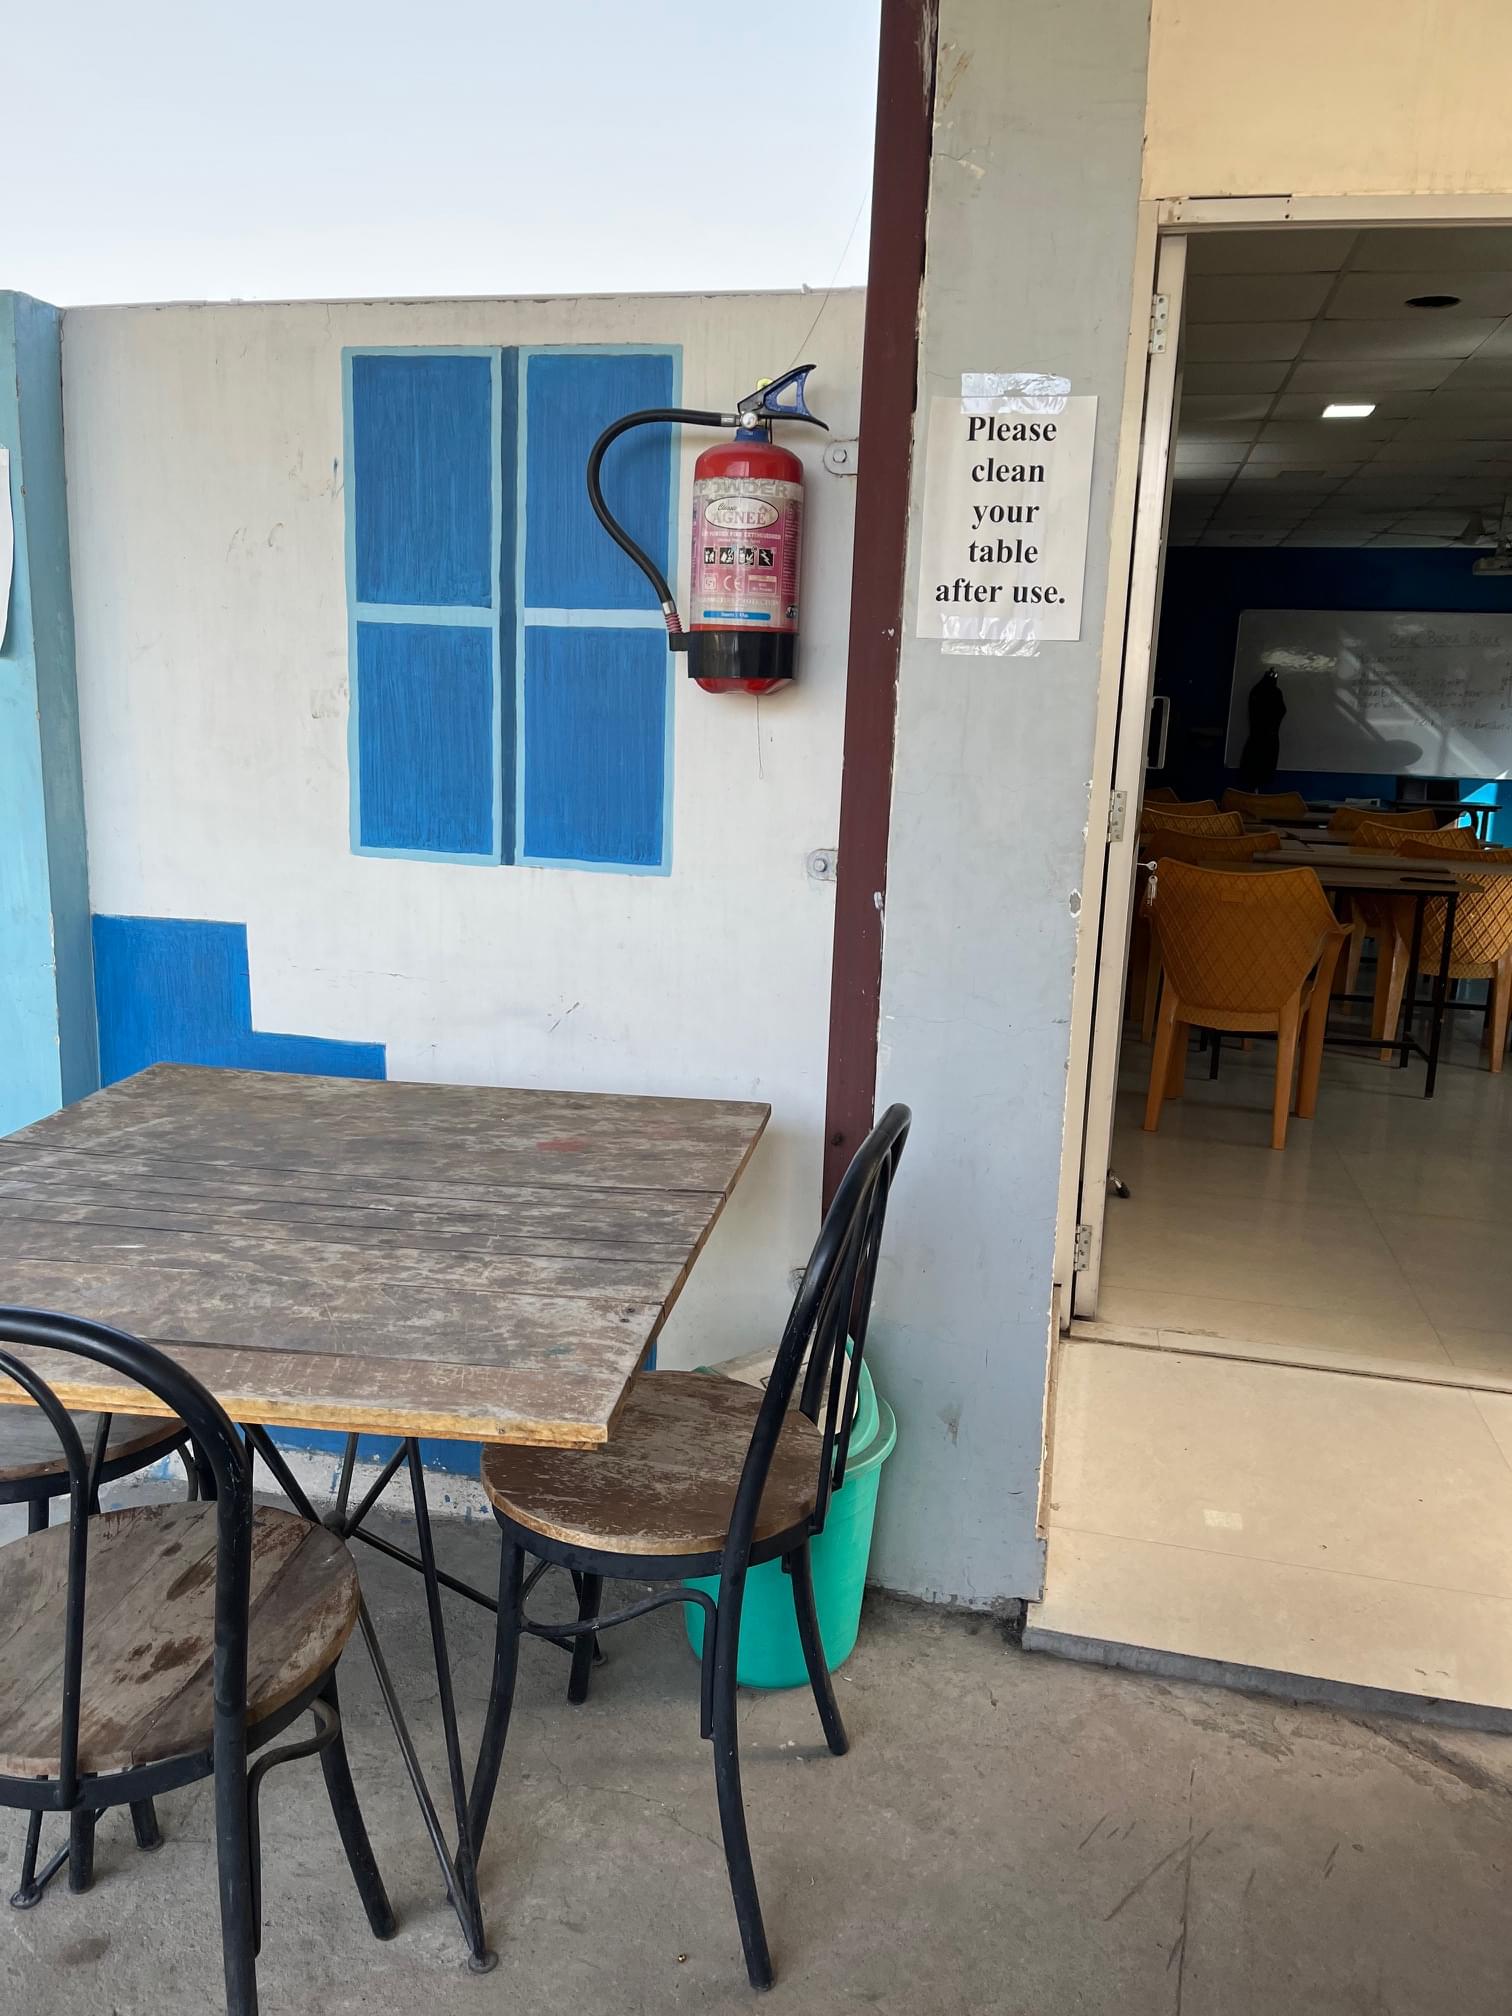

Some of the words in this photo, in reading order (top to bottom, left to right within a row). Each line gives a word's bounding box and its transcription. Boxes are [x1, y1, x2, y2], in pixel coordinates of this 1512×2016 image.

[967, 416, 1057, 441] Please
[971, 457, 1044, 482] clean
[971, 505, 1040, 529] your
[969, 538, 1038, 563] table
[935, 577, 1003, 602] after
[1013, 586, 1065, 603] use.
